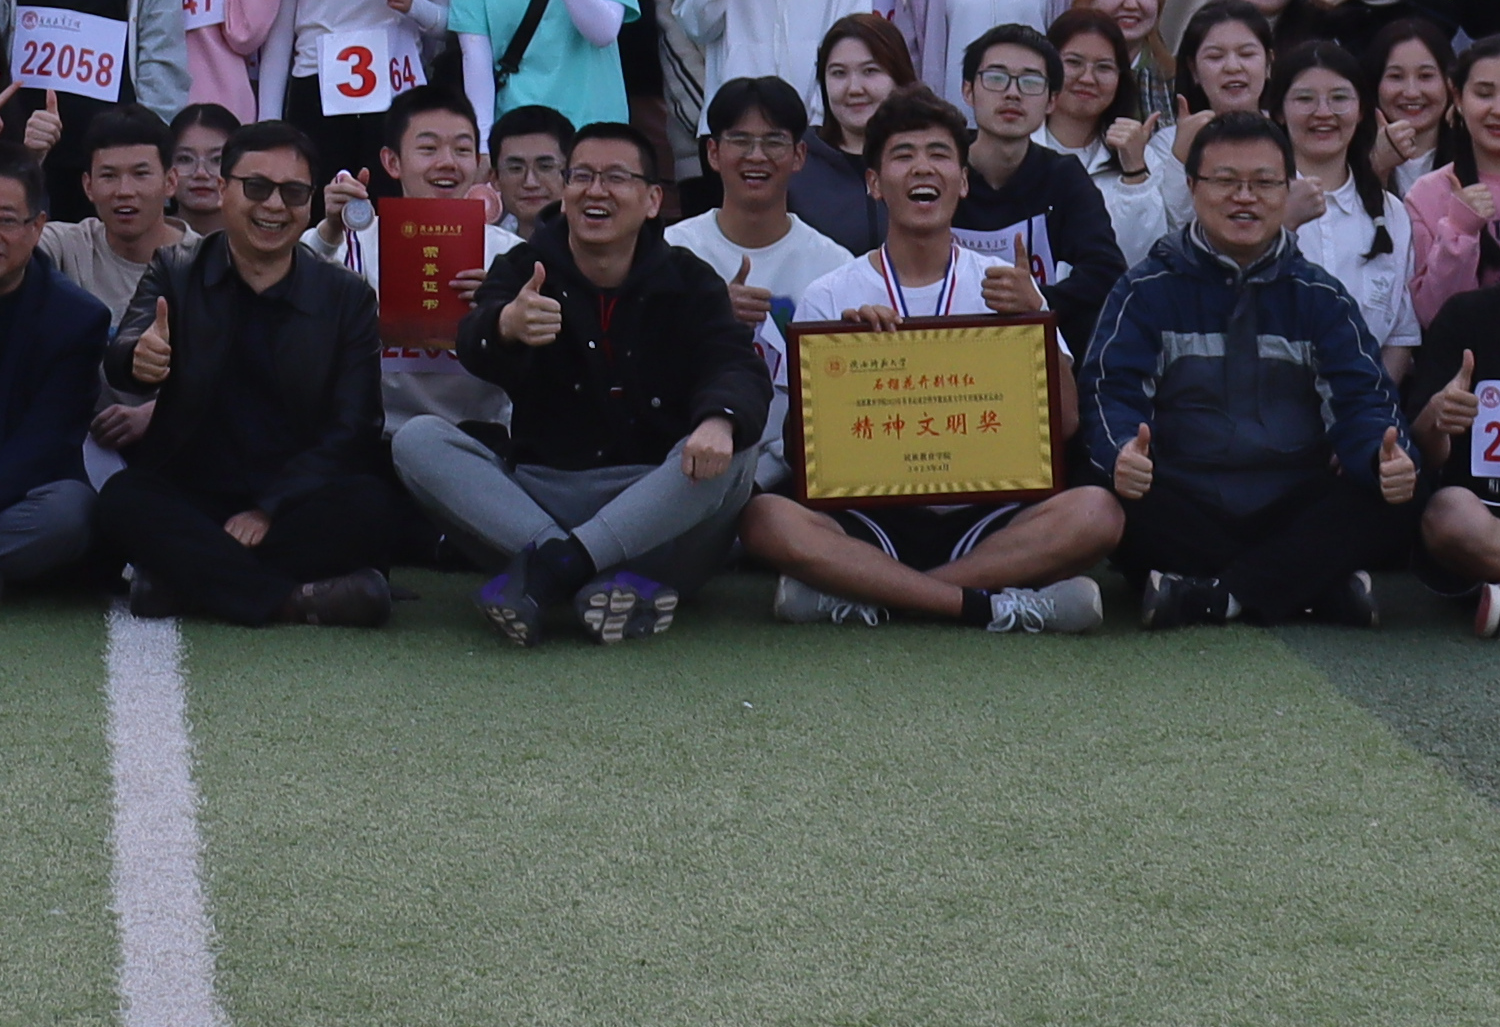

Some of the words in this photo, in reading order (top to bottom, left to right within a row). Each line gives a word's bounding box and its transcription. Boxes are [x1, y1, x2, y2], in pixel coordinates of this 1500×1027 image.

[20, 40, 114, 87] 22058
[336, 46, 377, 97] 3
[851, 410, 1002, 440] 精神文明奖
